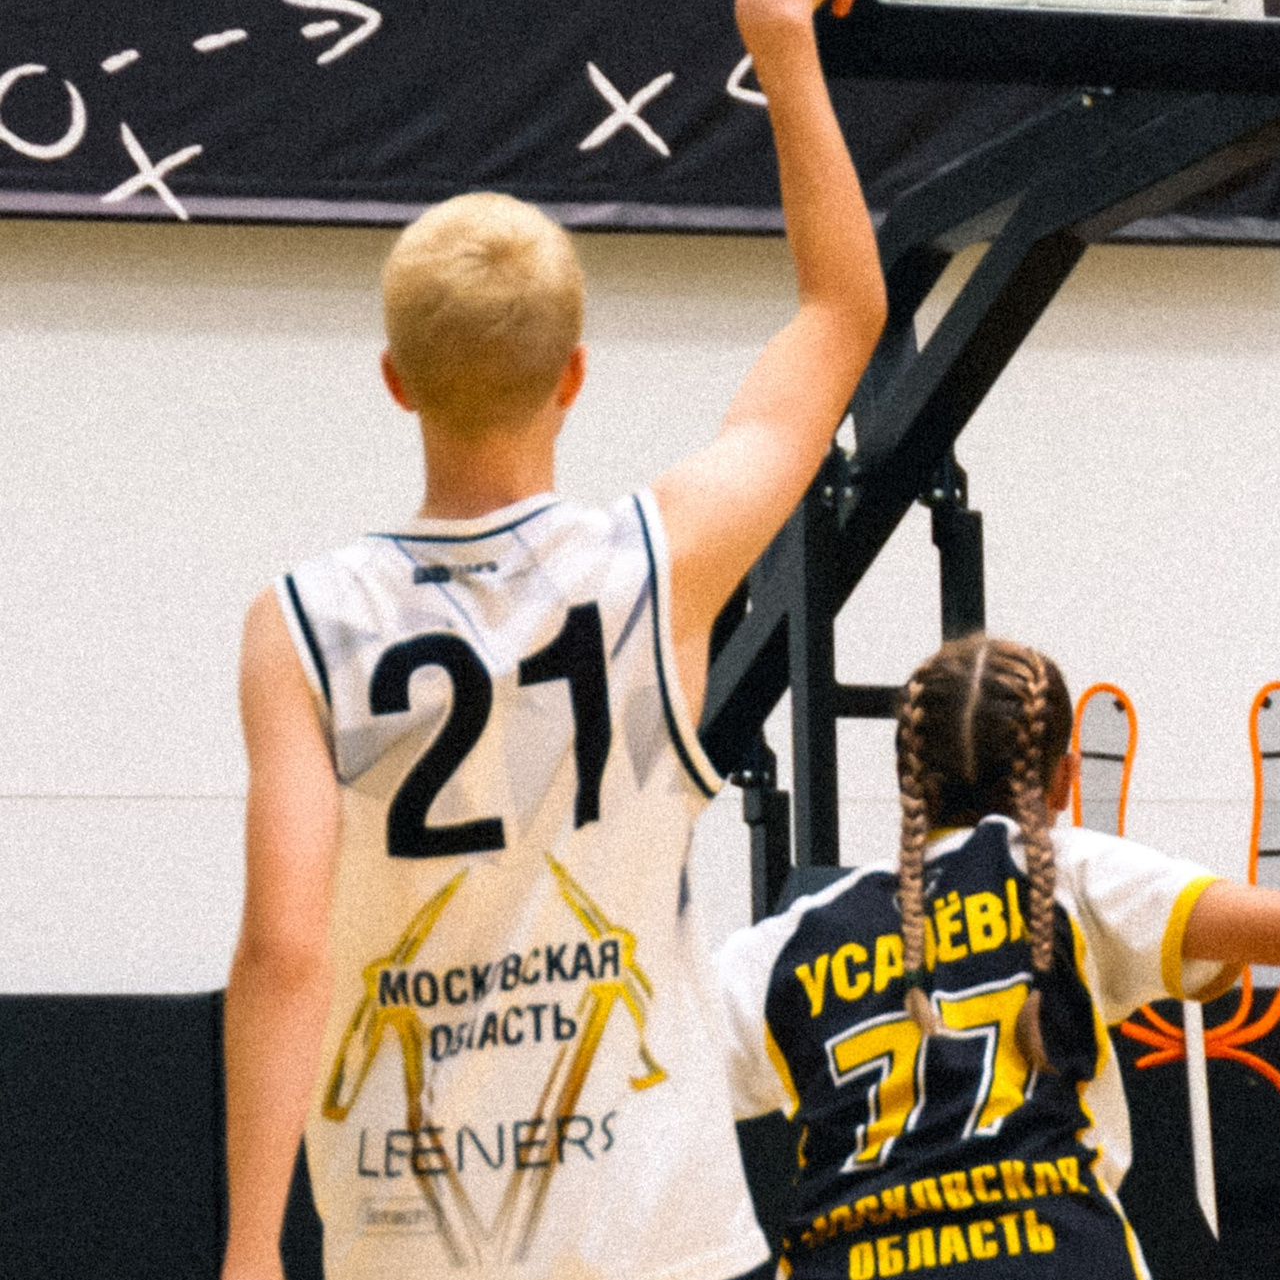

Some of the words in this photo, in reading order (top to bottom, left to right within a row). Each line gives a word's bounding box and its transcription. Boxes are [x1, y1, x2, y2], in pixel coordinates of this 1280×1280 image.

[369, 599, 613, 858] 21
[378, 940, 620, 1007] МОСКВСКАЯ
[825, 972, 1037, 1174] 77
